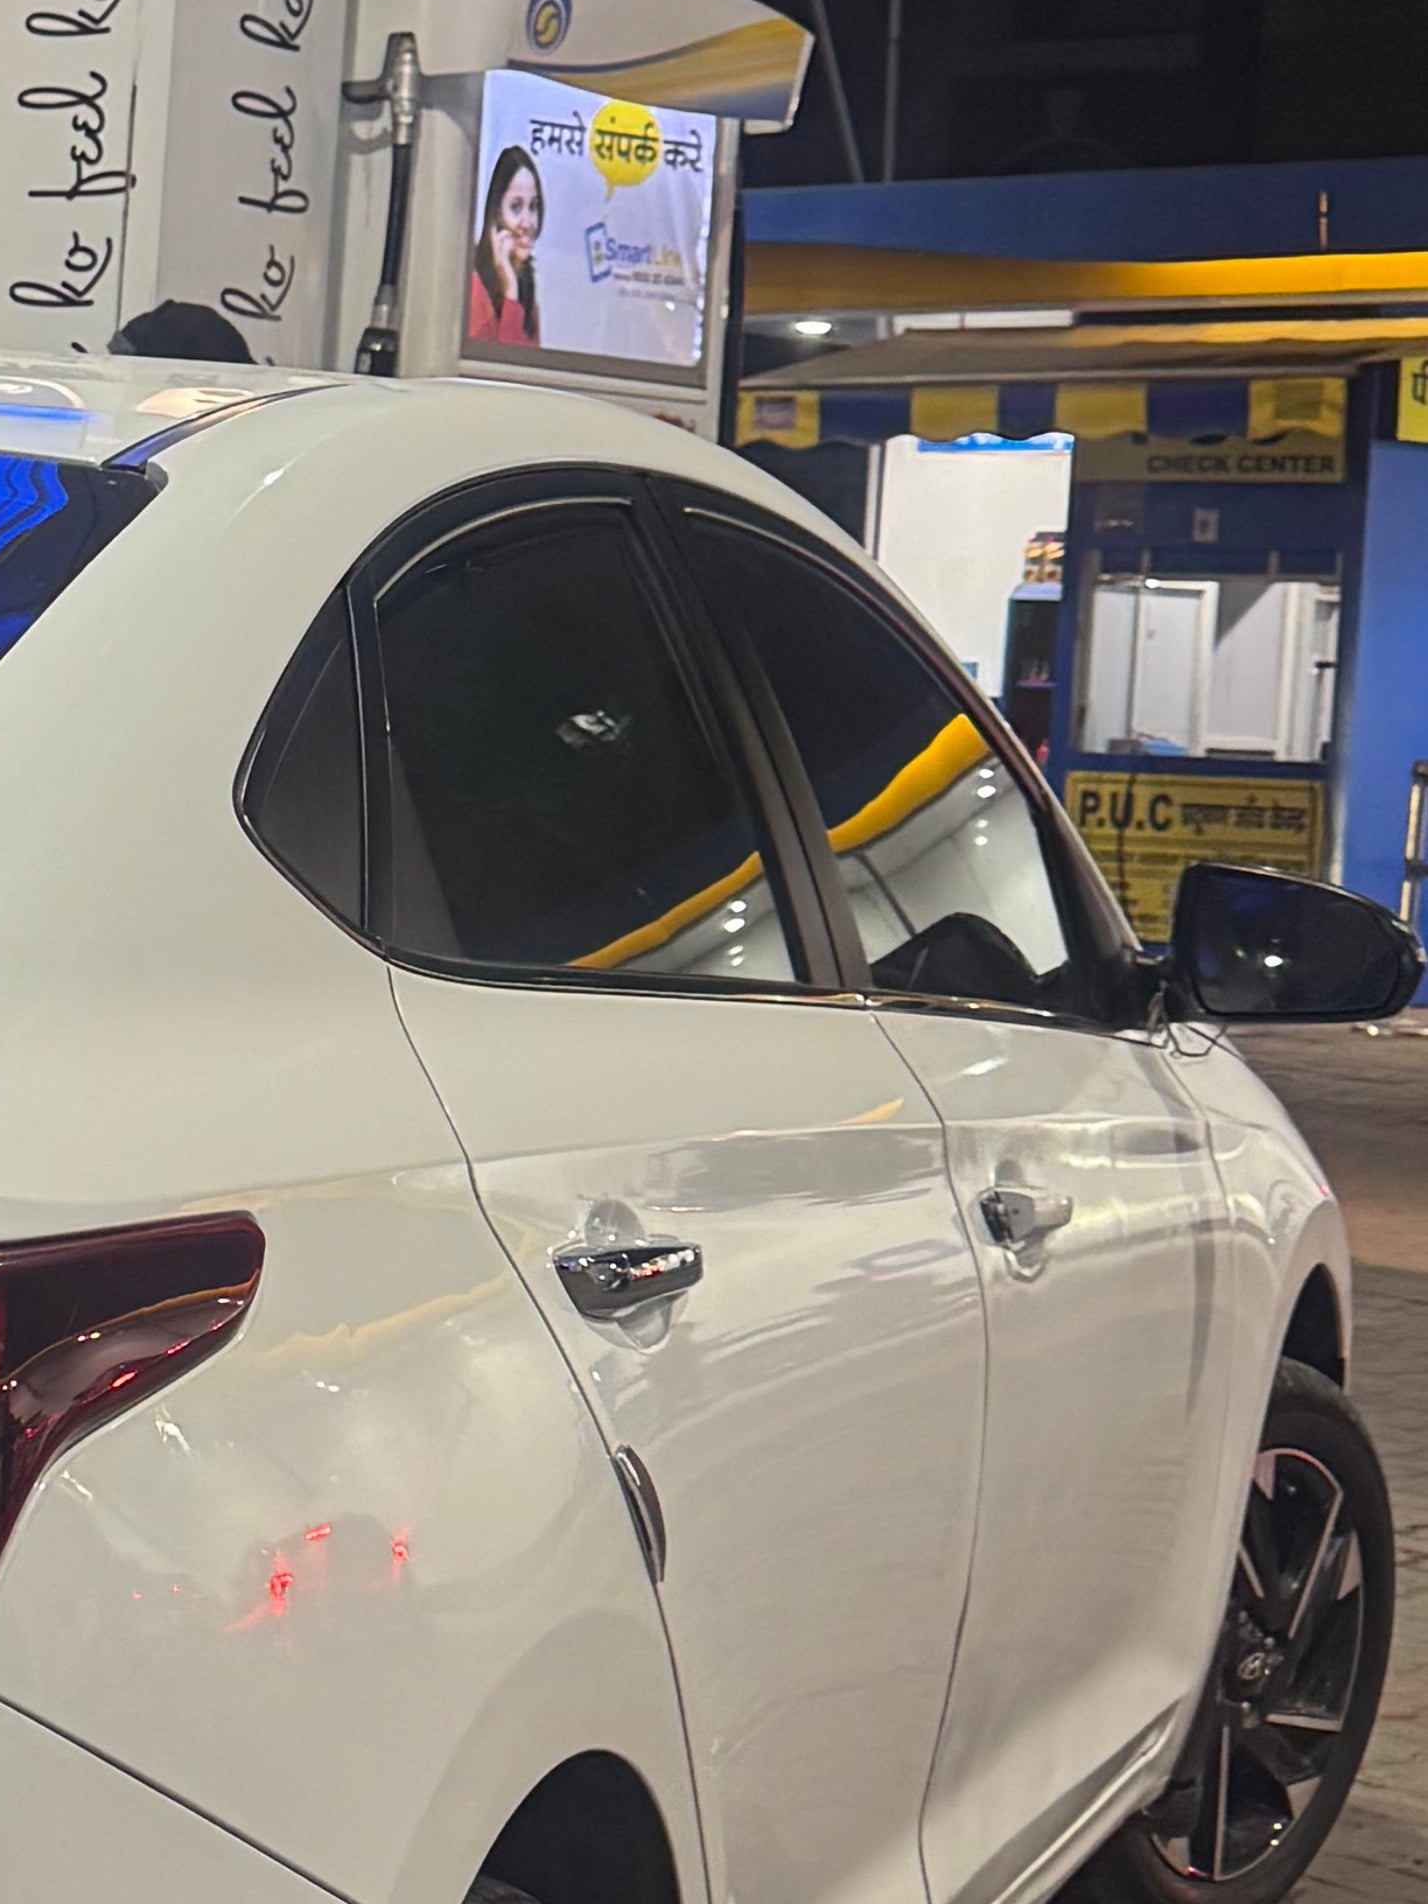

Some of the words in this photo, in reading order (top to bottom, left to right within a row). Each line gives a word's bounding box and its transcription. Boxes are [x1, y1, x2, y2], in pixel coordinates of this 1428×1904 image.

[17, 71, 138, 200] feel
[231, 86, 310, 214] feel
[530, 110, 587, 157] हमसे
[595, 116, 660, 166] संपर्क
[9, 231, 113, 308] ko
[221, 244, 296, 323] ko
[1147, 454, 1231, 474] CHECK
[1238, 454, 1336, 475] CENTER
[1078, 789, 1174, 832] P.U.C
